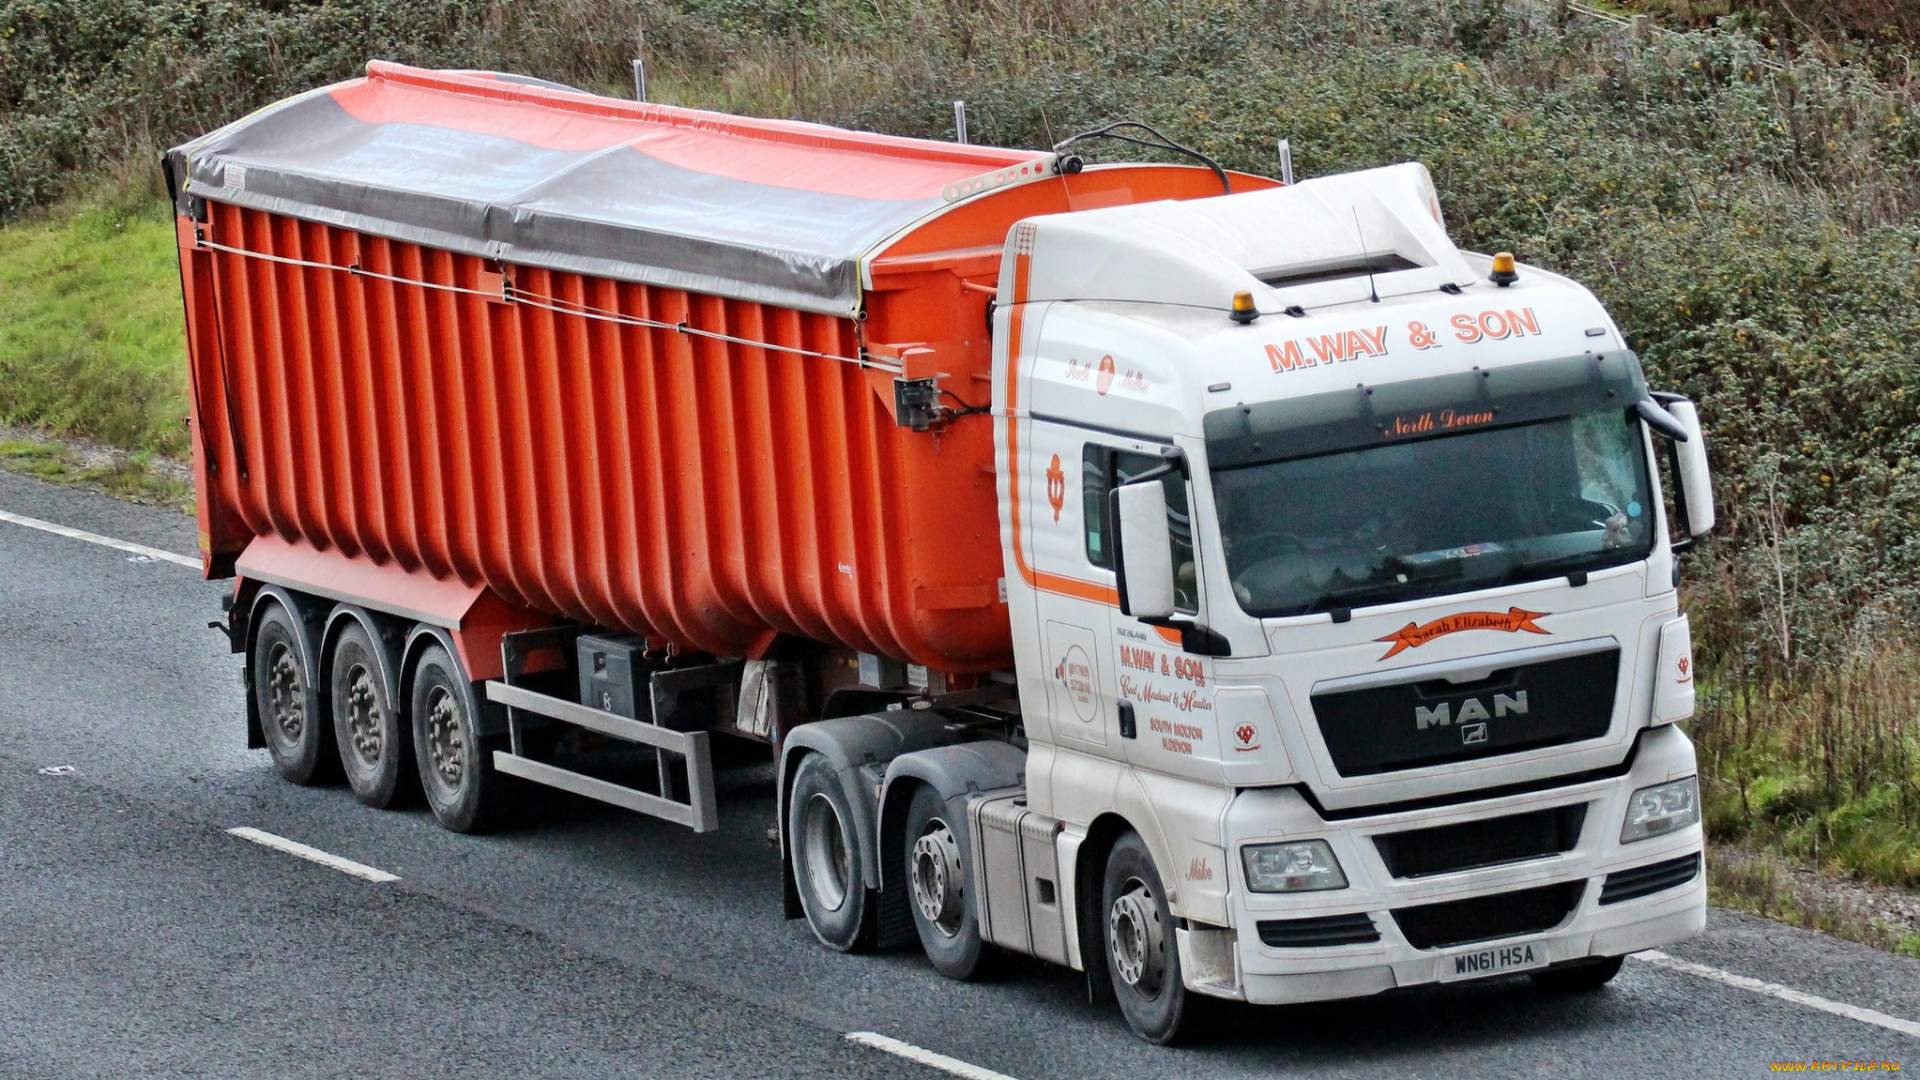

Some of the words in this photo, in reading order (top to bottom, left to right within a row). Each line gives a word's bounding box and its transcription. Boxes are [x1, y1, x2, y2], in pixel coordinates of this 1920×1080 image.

[1264, 325, 1388, 374] M.WAY
[1408, 320, 1441, 350] &
[1450, 307, 1541, 344] SON
[1384, 413, 1435, 437] North
[1440, 408, 1494, 428] Devon
[1413, 621, 1450, 643] Sarah
[1454, 615, 1511, 630] Elizabeth
[1120, 645, 1155, 673] M.WAY
[1161, 654, 1170, 677] &
[1175, 656, 1205, 681] SON
[1415, 690, 1529, 730] MAN
[1149, 717, 1173, 734] SOUTH
[1173, 722, 1203, 741] MOLTON
[1185, 858, 1212, 881] Mike
[1455, 951, 1495, 974] WN61
[1500, 945, 1534, 967] HSA
